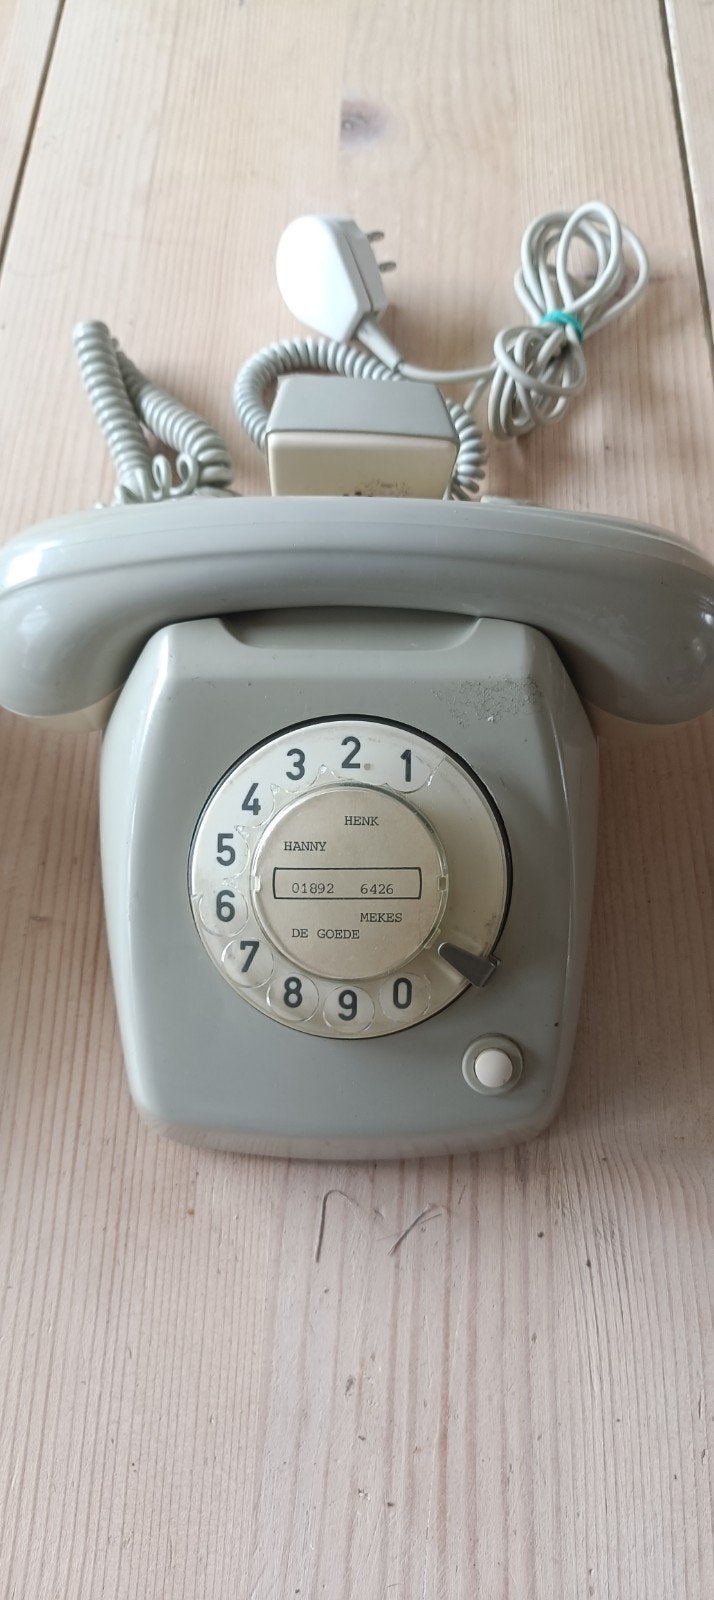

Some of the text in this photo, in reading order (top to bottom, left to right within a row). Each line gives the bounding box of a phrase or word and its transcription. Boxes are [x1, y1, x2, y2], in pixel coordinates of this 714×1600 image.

[286, 748, 306, 781] 3
[340, 736, 361, 769] 2
[400, 749, 412, 783] 1
[241, 783, 262, 816] 4
[344, 815, 380, 827] HENK
[215, 832, 236, 866] 5
[283, 841, 327, 852] HANNY
[291, 882, 394, 895] 01892 6426
[215, 889, 236, 923] 6
[360, 912, 403, 923] MEKES
[291, 928, 360, 940] DE GOEDE
[239, 940, 260, 973] 7
[283, 976, 303, 1009] 8
[338, 989, 358, 1022] 9
[392, 977, 413, 1010] 0
